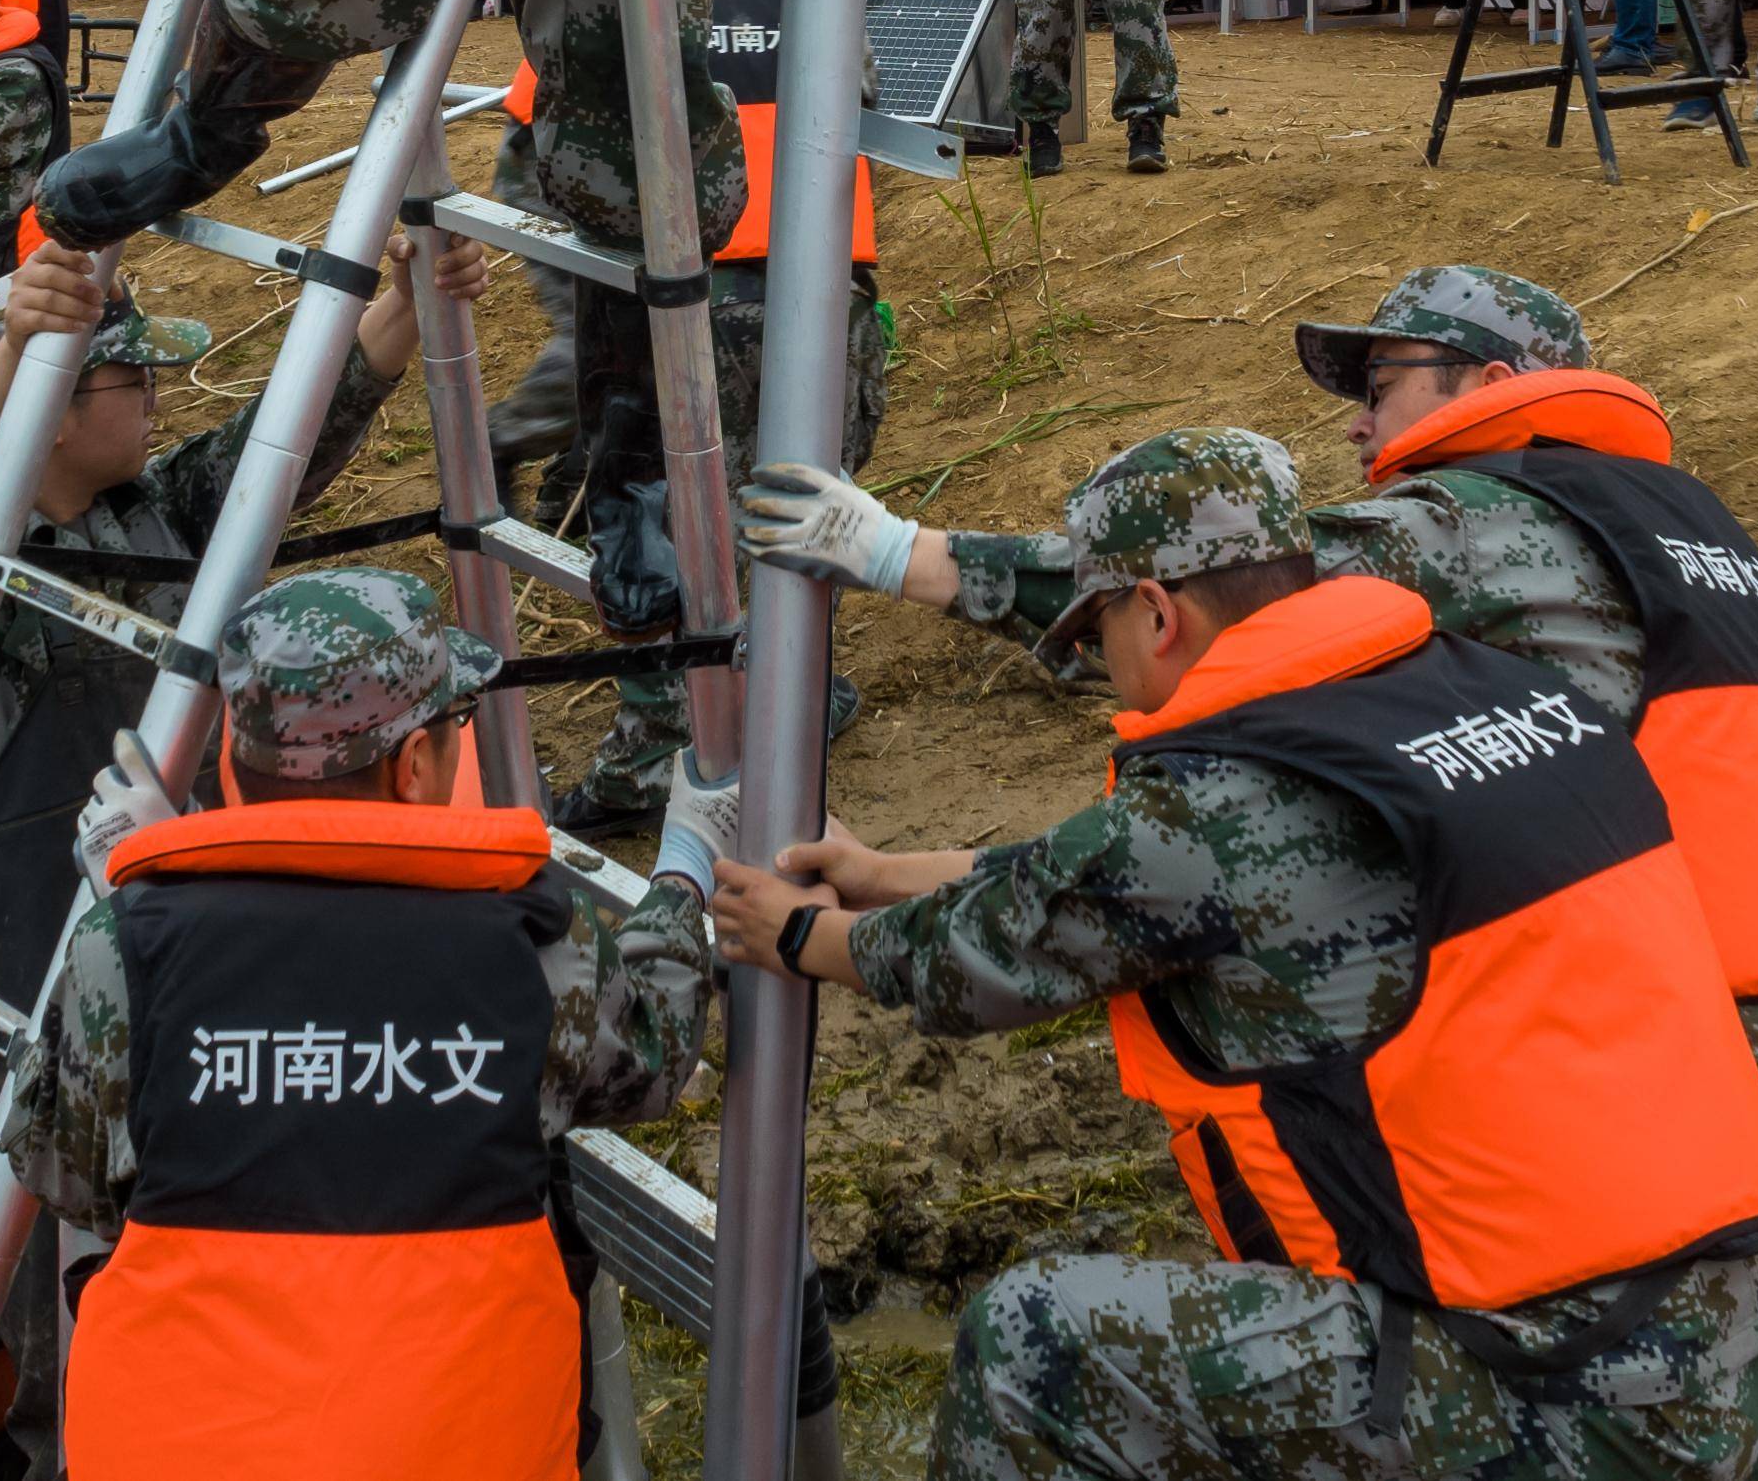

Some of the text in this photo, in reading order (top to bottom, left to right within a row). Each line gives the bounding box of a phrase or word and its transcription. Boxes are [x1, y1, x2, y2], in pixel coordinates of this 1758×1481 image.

[1395, 689, 1606, 791] 河南水文
[189, 1021, 504, 1105] 河南水文
